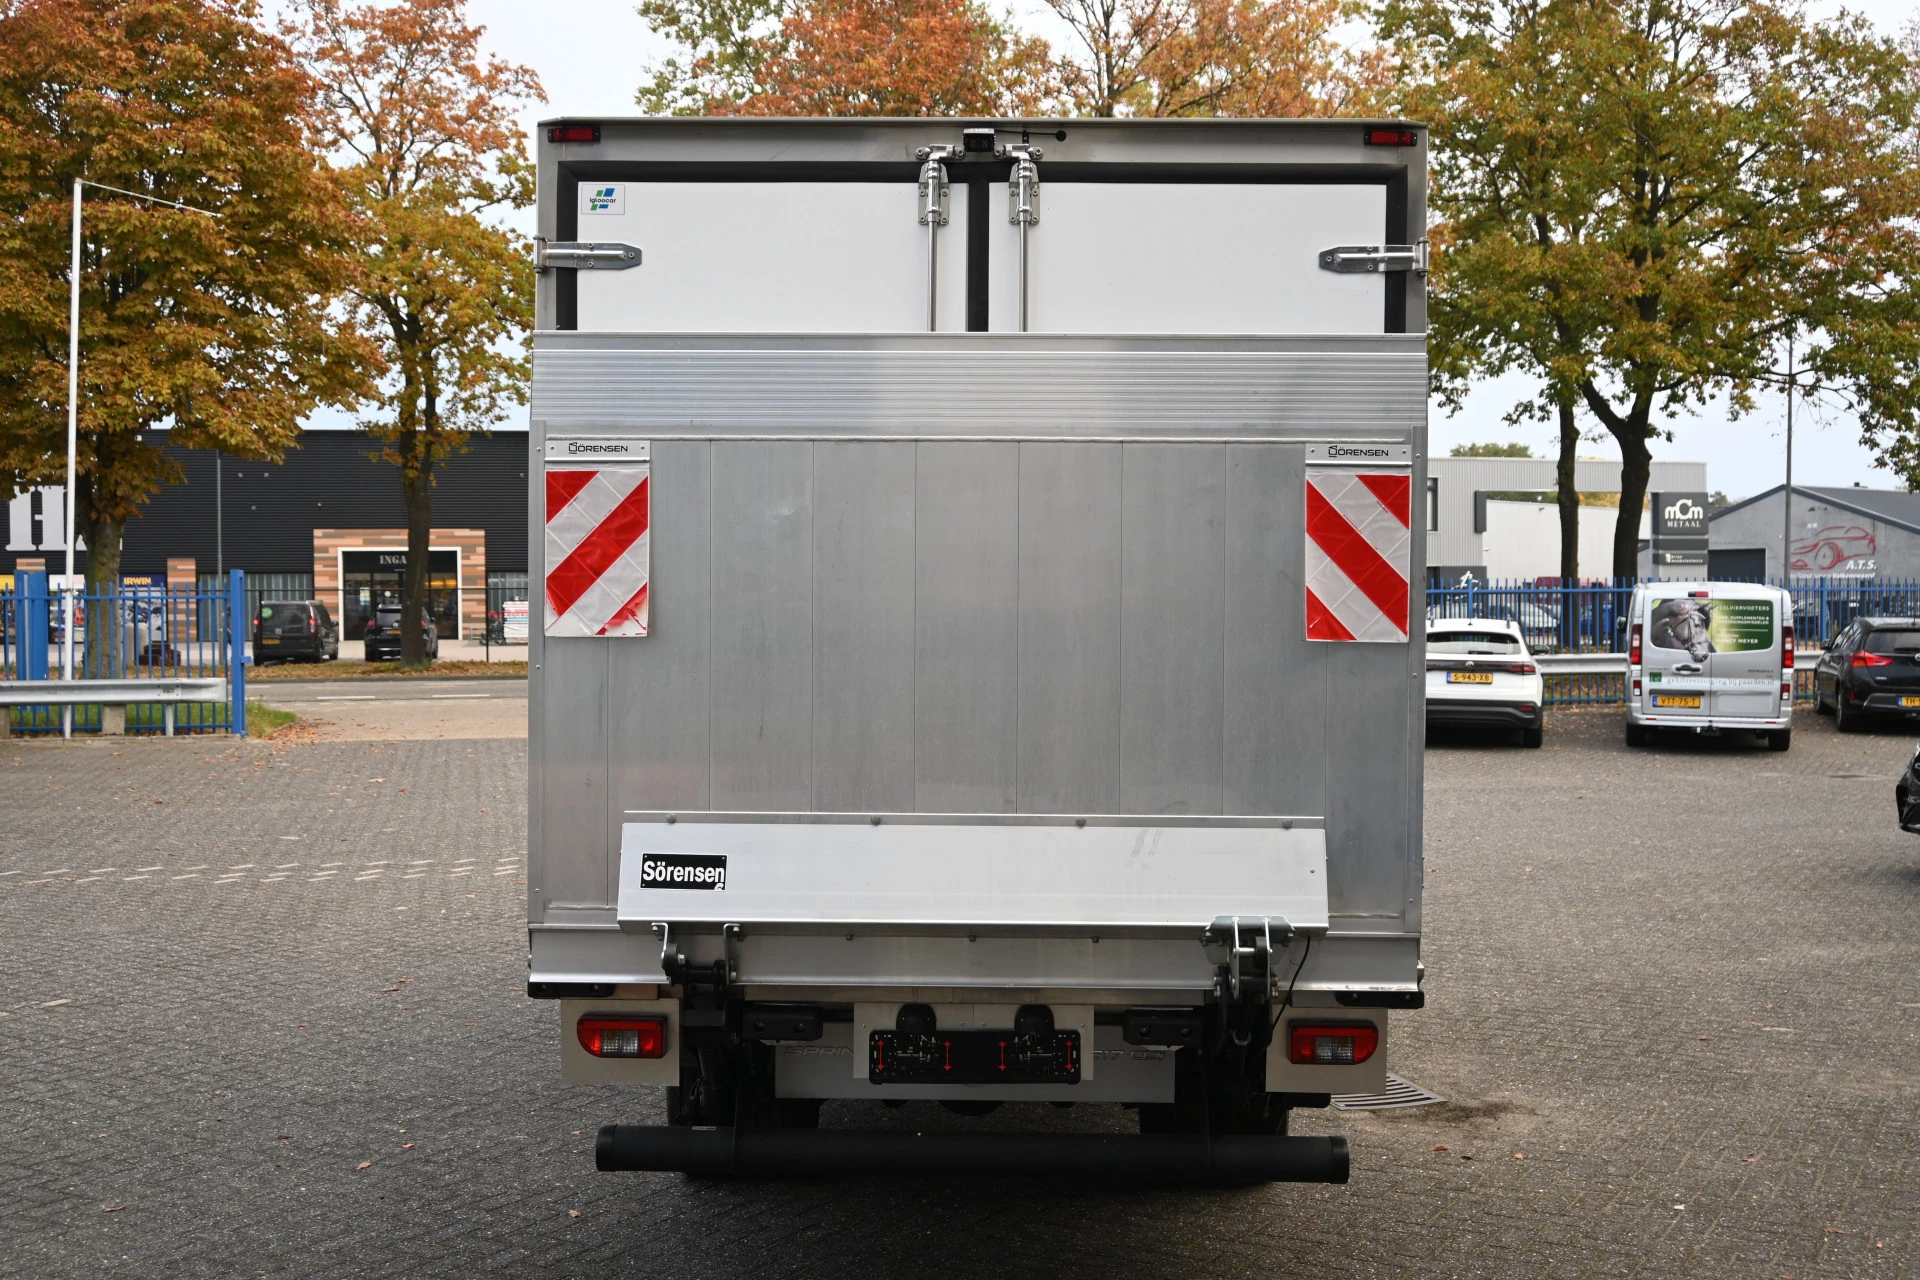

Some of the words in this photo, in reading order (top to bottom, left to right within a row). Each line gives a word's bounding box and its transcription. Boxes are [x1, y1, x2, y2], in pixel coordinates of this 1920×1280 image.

[1667, 520, 1701, 528] METAAL
[379, 555, 407, 564] INGA
[1845, 560, 1877, 570] A.T.S.
[123, 577, 152, 585] IRWIN
[1454, 673, 1489, 681] S-943-XB
[1661, 696, 1696, 705] VTT-75-T
[642, 861, 726, 883] Sörensen
[785, 1045, 854, 1057] SPRIN
